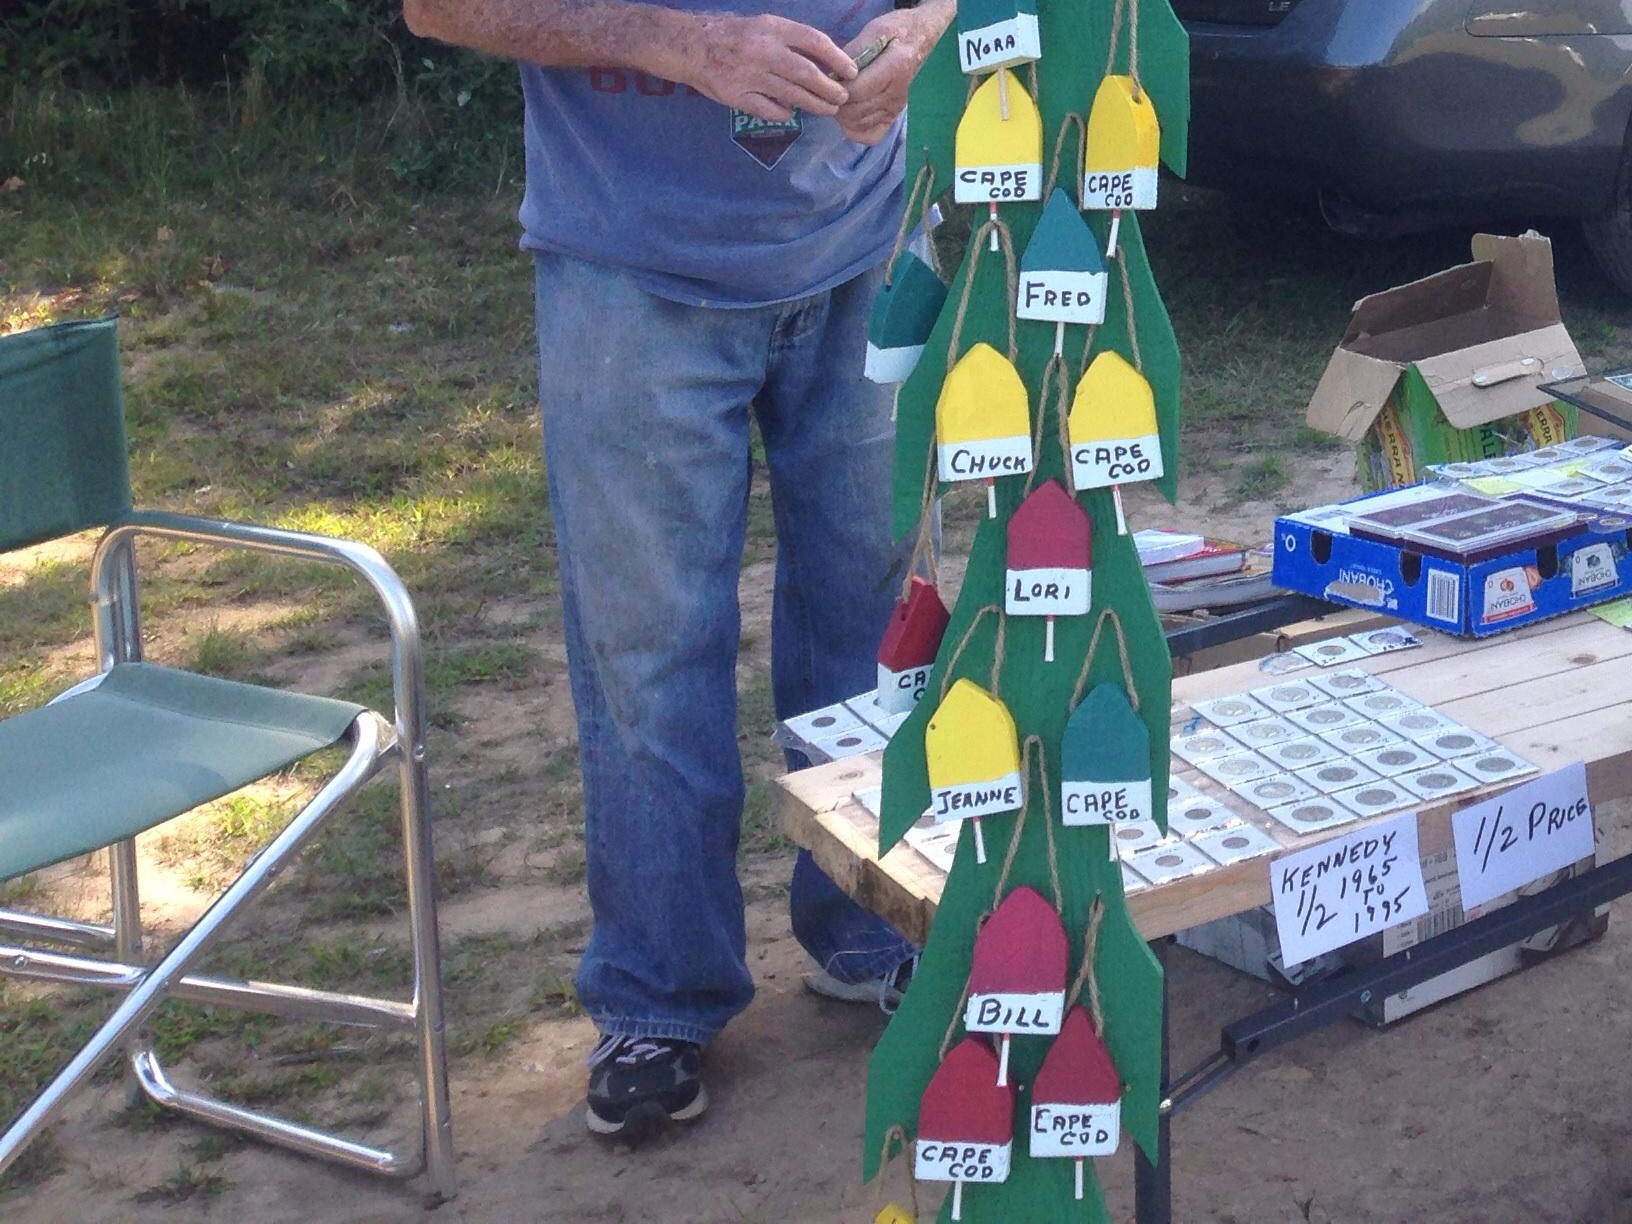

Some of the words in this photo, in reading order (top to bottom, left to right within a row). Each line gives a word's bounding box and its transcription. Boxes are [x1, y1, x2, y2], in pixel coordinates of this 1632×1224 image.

[966, 34, 1017, 66] NORA
[960, 170, 1028, 187] CAPE
[1088, 173, 1133, 193] CAPE
[989, 186, 1026, 199] COD
[1105, 193, 1134, 207] COD
[1026, 282, 1091, 308] FRED
[951, 449, 1026, 474] CHUCK
[1075, 443, 1143, 465] CAPE
[1108, 459, 1150, 478] COD
[1014, 579, 1070, 602] LORI
[898, 670, 931, 689] CA
[937, 786, 1017, 815] JEANNE
[1066, 787, 1129, 814] CAPE
[1103, 808, 1140, 820] COD
[1473, 806, 1519, 873] 1/2
[1528, 795, 1588, 842] PRICE
[1281, 832, 1398, 894] KENNEDY
[1340, 856, 1398, 899] 1965
[1296, 887, 1338, 937] 1/2
[1353, 887, 1411, 934] 1995
[977, 998, 1050, 1028] BILL
[1034, 1108, 1092, 1133] CAPE
[1060, 1130, 1109, 1146] COD
[921, 1146, 993, 1164] CAPE
[949, 1163, 994, 1179] COD
